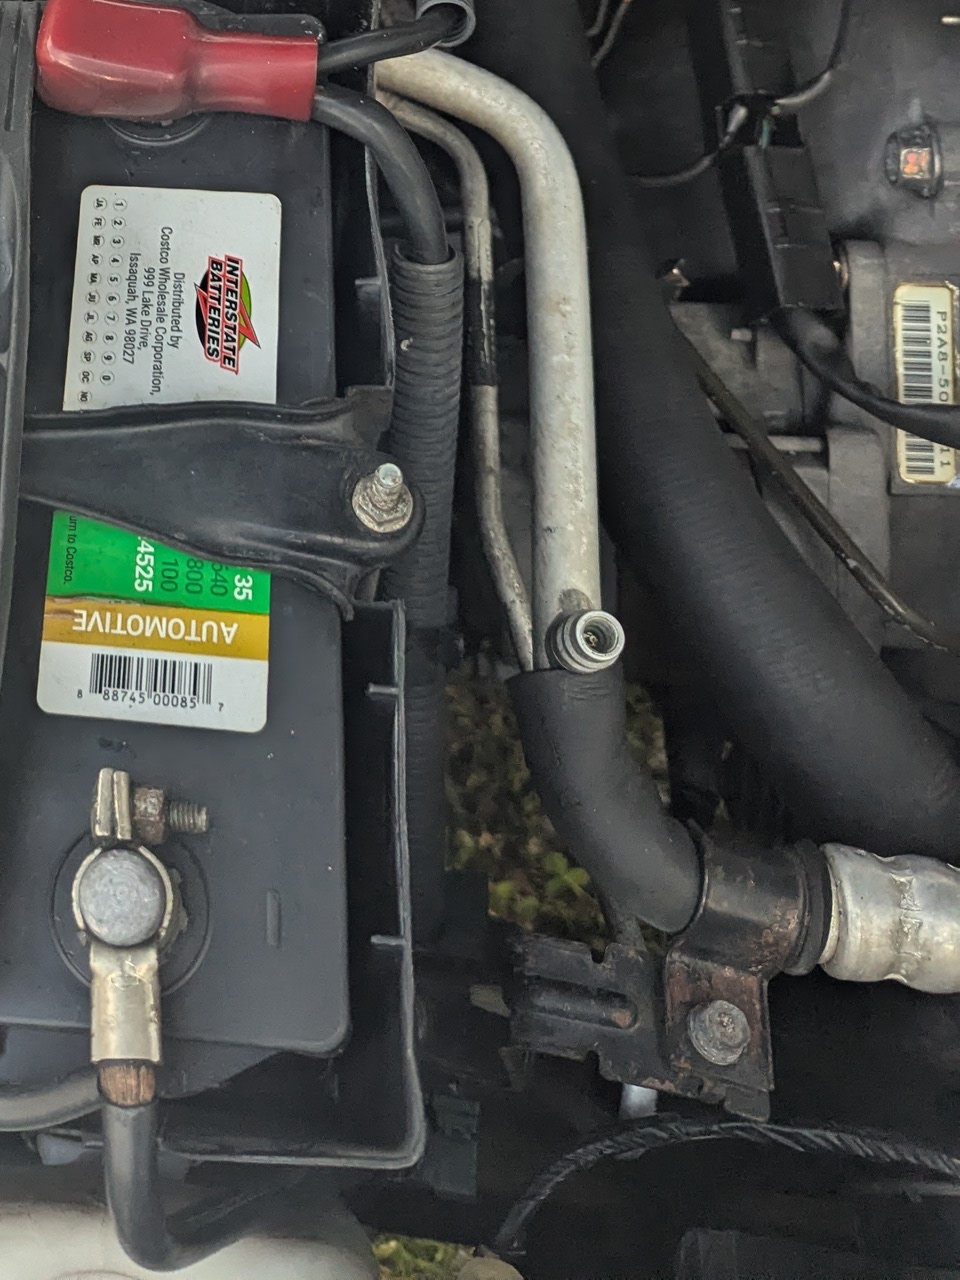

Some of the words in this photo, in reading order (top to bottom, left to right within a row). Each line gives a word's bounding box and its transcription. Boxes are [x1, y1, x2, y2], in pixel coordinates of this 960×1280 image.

[159, 227, 173, 264] Costco
[125, 253, 141, 304] Issaquah,
[143, 267, 155, 287] 999
[140, 290, 154, 316] Lake
[155, 267, 170, 323] Wholesale
[170, 272, 185, 332] Distributed
[207, 259, 224, 359] BATTERIES
[222, 257, 240, 368] INTERSTATE
[125, 307, 137, 325] WA
[123, 329, 136, 364] 98027
[137, 319, 152, 350] Drive,
[167, 335, 181, 349] by
[149, 326, 167, 396] Corporation,
[66, 533, 76, 544] to
[63, 546, 77, 585] Costco.
[160, 558, 179, 593] 100
[185, 558, 205, 595] 800
[234, 574, 253, 601] 35
[72, 609, 238, 645] AUTOMOTIVE
[76, 688, 84, 700] 8
[102, 687, 146, 705] 88745
[152, 693, 197, 709] 00085
[217, 702, 225, 712] 7
